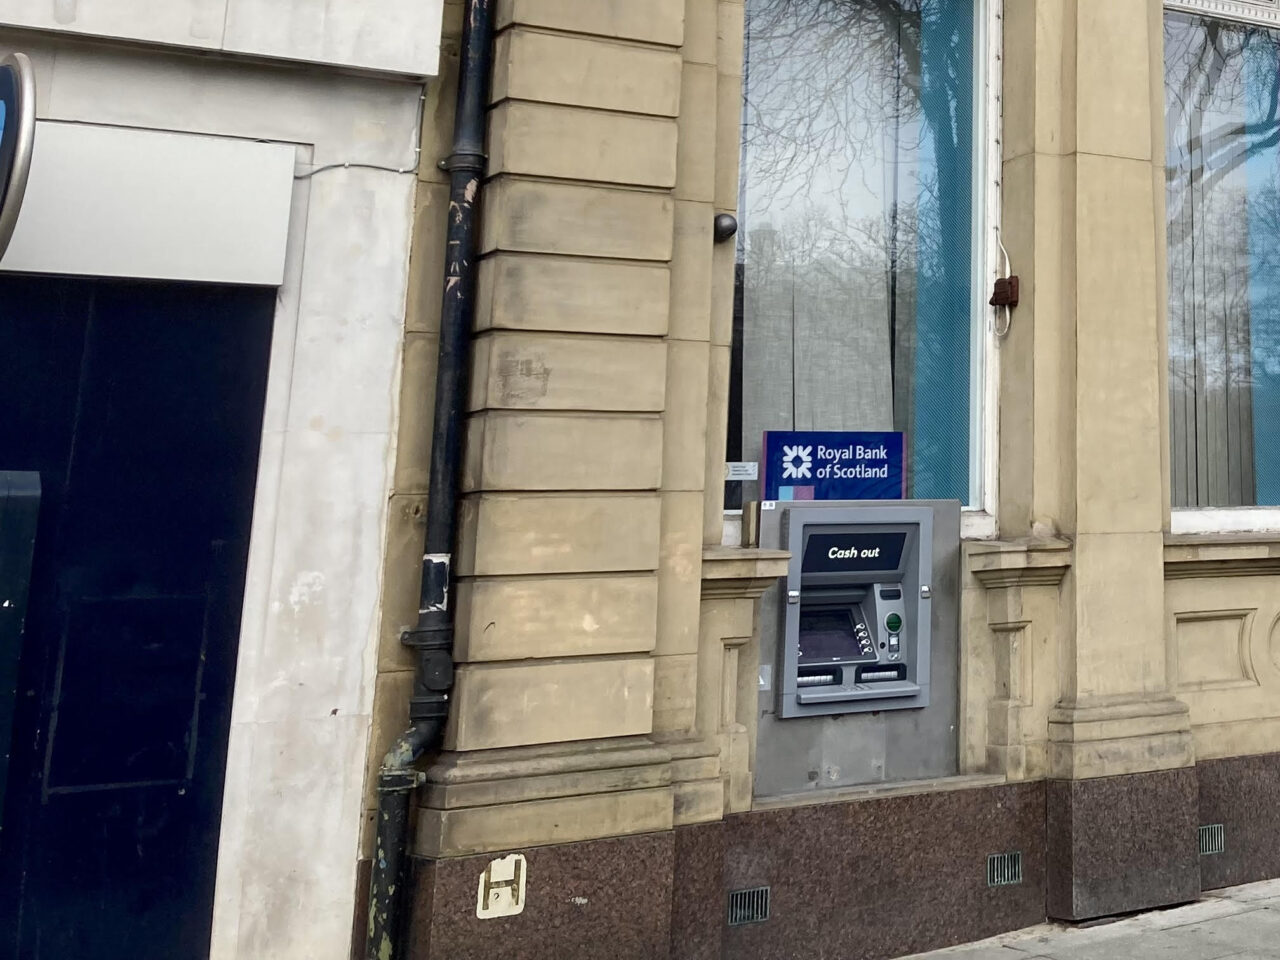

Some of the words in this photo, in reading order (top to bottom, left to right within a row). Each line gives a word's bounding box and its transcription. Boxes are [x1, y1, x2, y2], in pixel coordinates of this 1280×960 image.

[817, 445, 853, 463] Royal
[856, 445, 888, 459] Bank
[817, 464, 832, 478] of
[833, 464, 888, 478] Scotland
[828, 547, 858, 559] Cash
[861, 548, 880, 558] out
